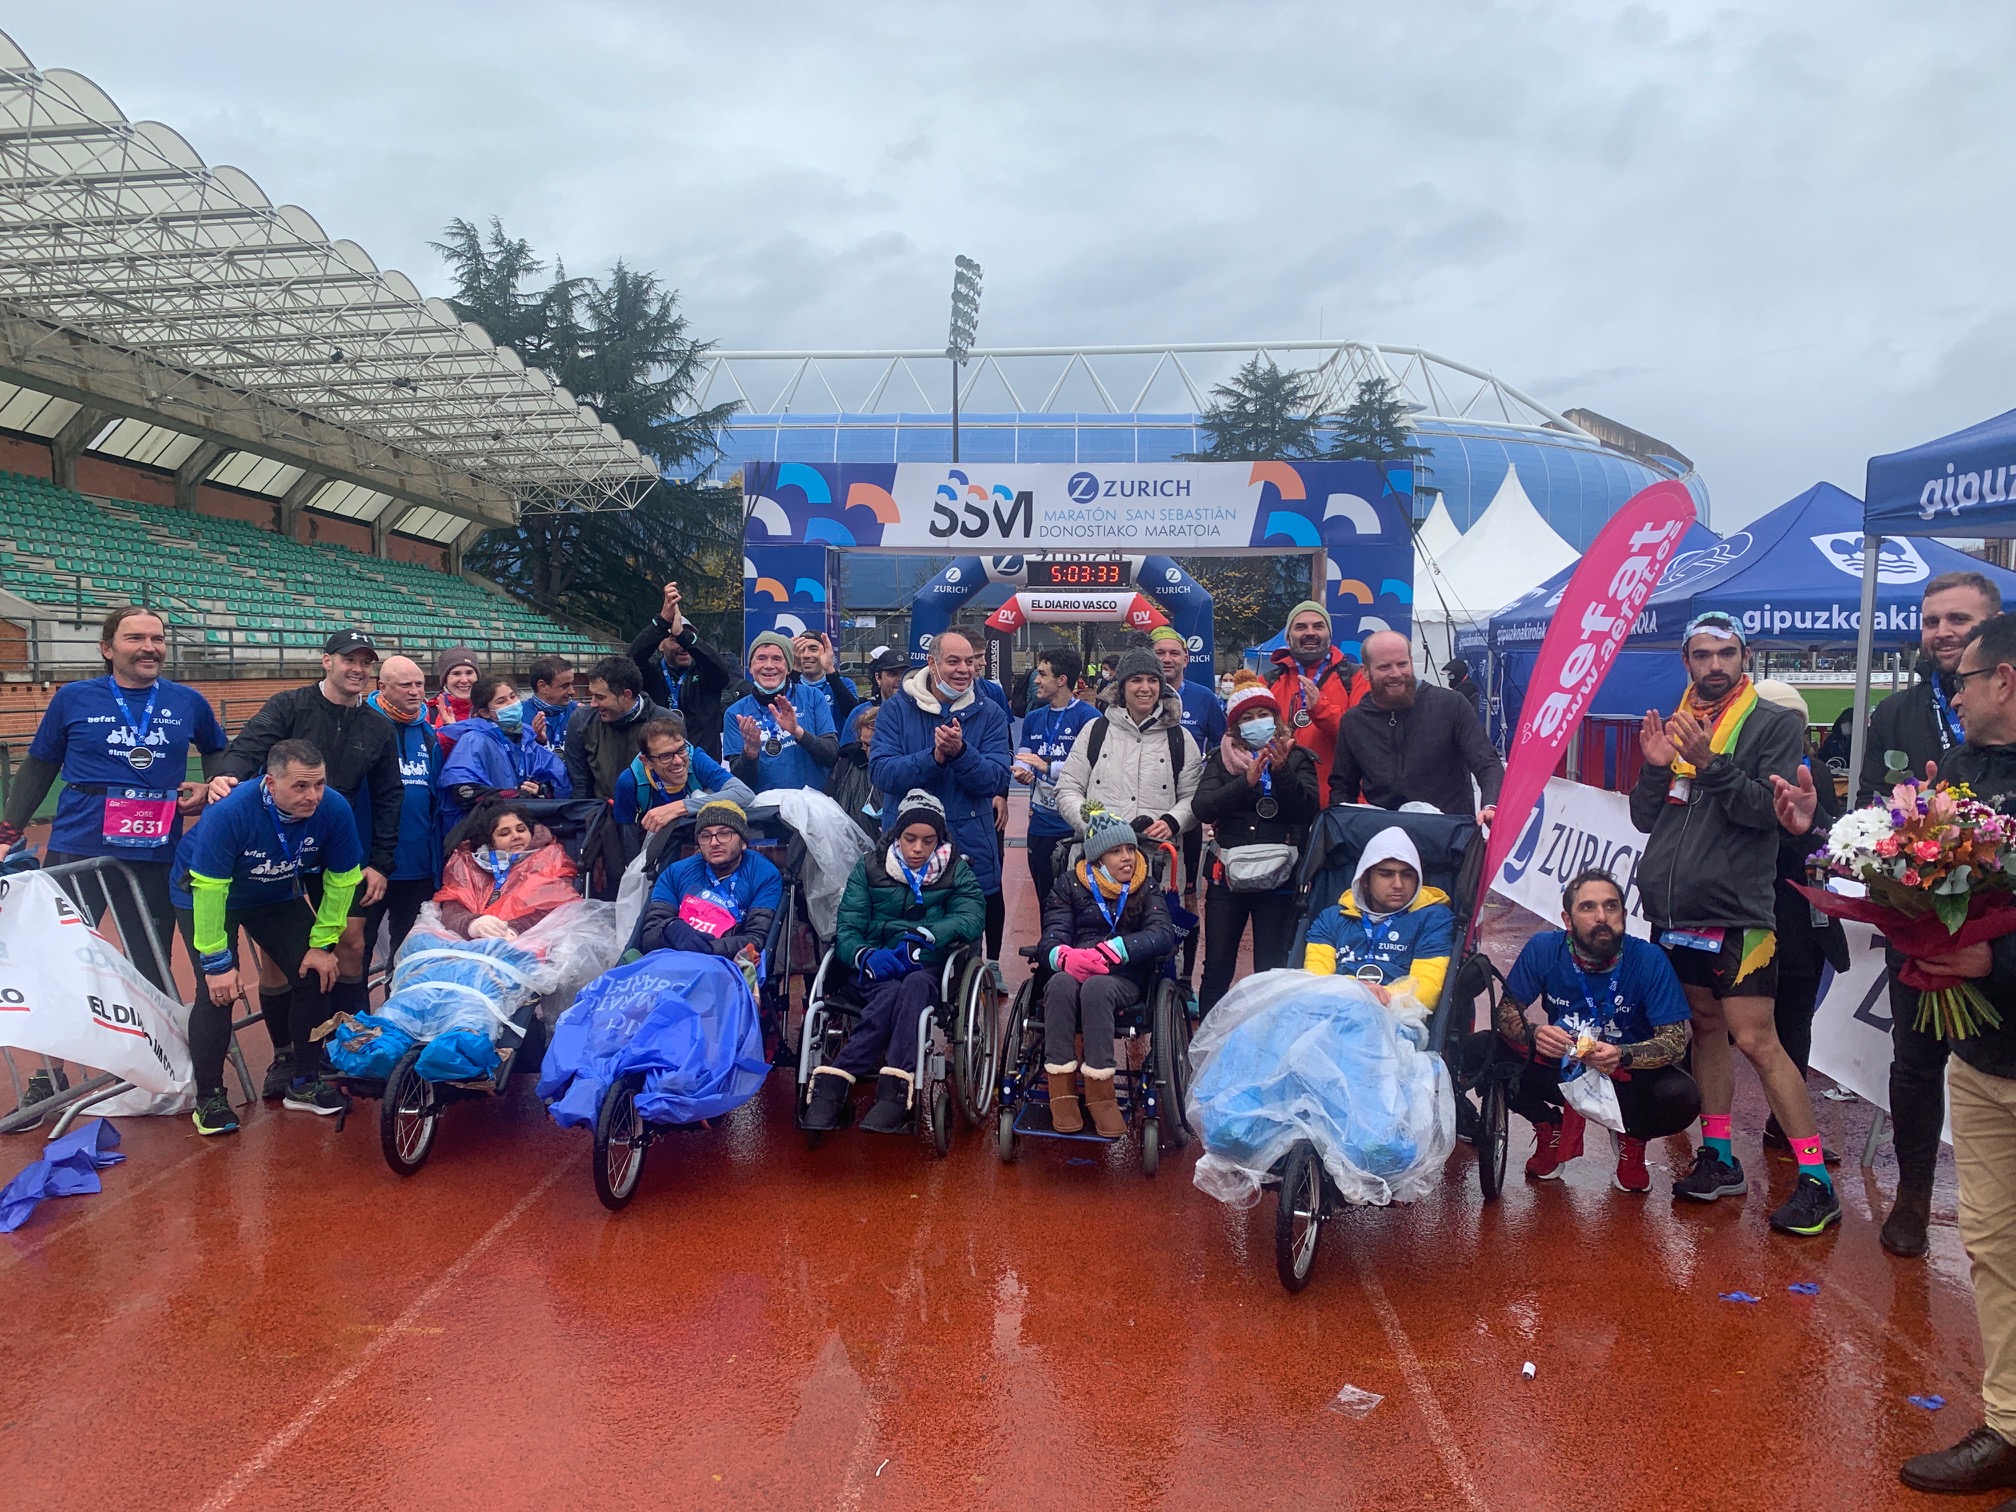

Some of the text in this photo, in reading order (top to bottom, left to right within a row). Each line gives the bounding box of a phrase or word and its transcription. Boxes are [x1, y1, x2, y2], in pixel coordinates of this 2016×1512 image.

[1102, 479, 1192, 498] ZURICH
[928, 470, 1034, 539] SSM
[1043, 506, 1237, 522] MARATÓN SAN SEBASTIÁN
[1039, 524, 1221, 538] DONOSTIAKO MARATOIA
[1051, 565, 1119, 582] 5:03:33
[933, 585, 968, 594] ZURICH
[1156, 585, 1191, 594] ZURICH
[1031, 600, 1118, 610] EL DIARIO VASCO
[999, 609, 1017, 621] DV
[1133, 610, 1151, 622] DV
[1532, 519, 1675, 738] aefat
[990, 640, 998, 663] VASCO
[152, 717, 182, 726] ZURICH
[133, 810, 154, 818] JOSE
[119, 818, 163, 835] 2631
[1378, 942, 1408, 952] ZURICH
[86, 995, 111, 1021] EL
